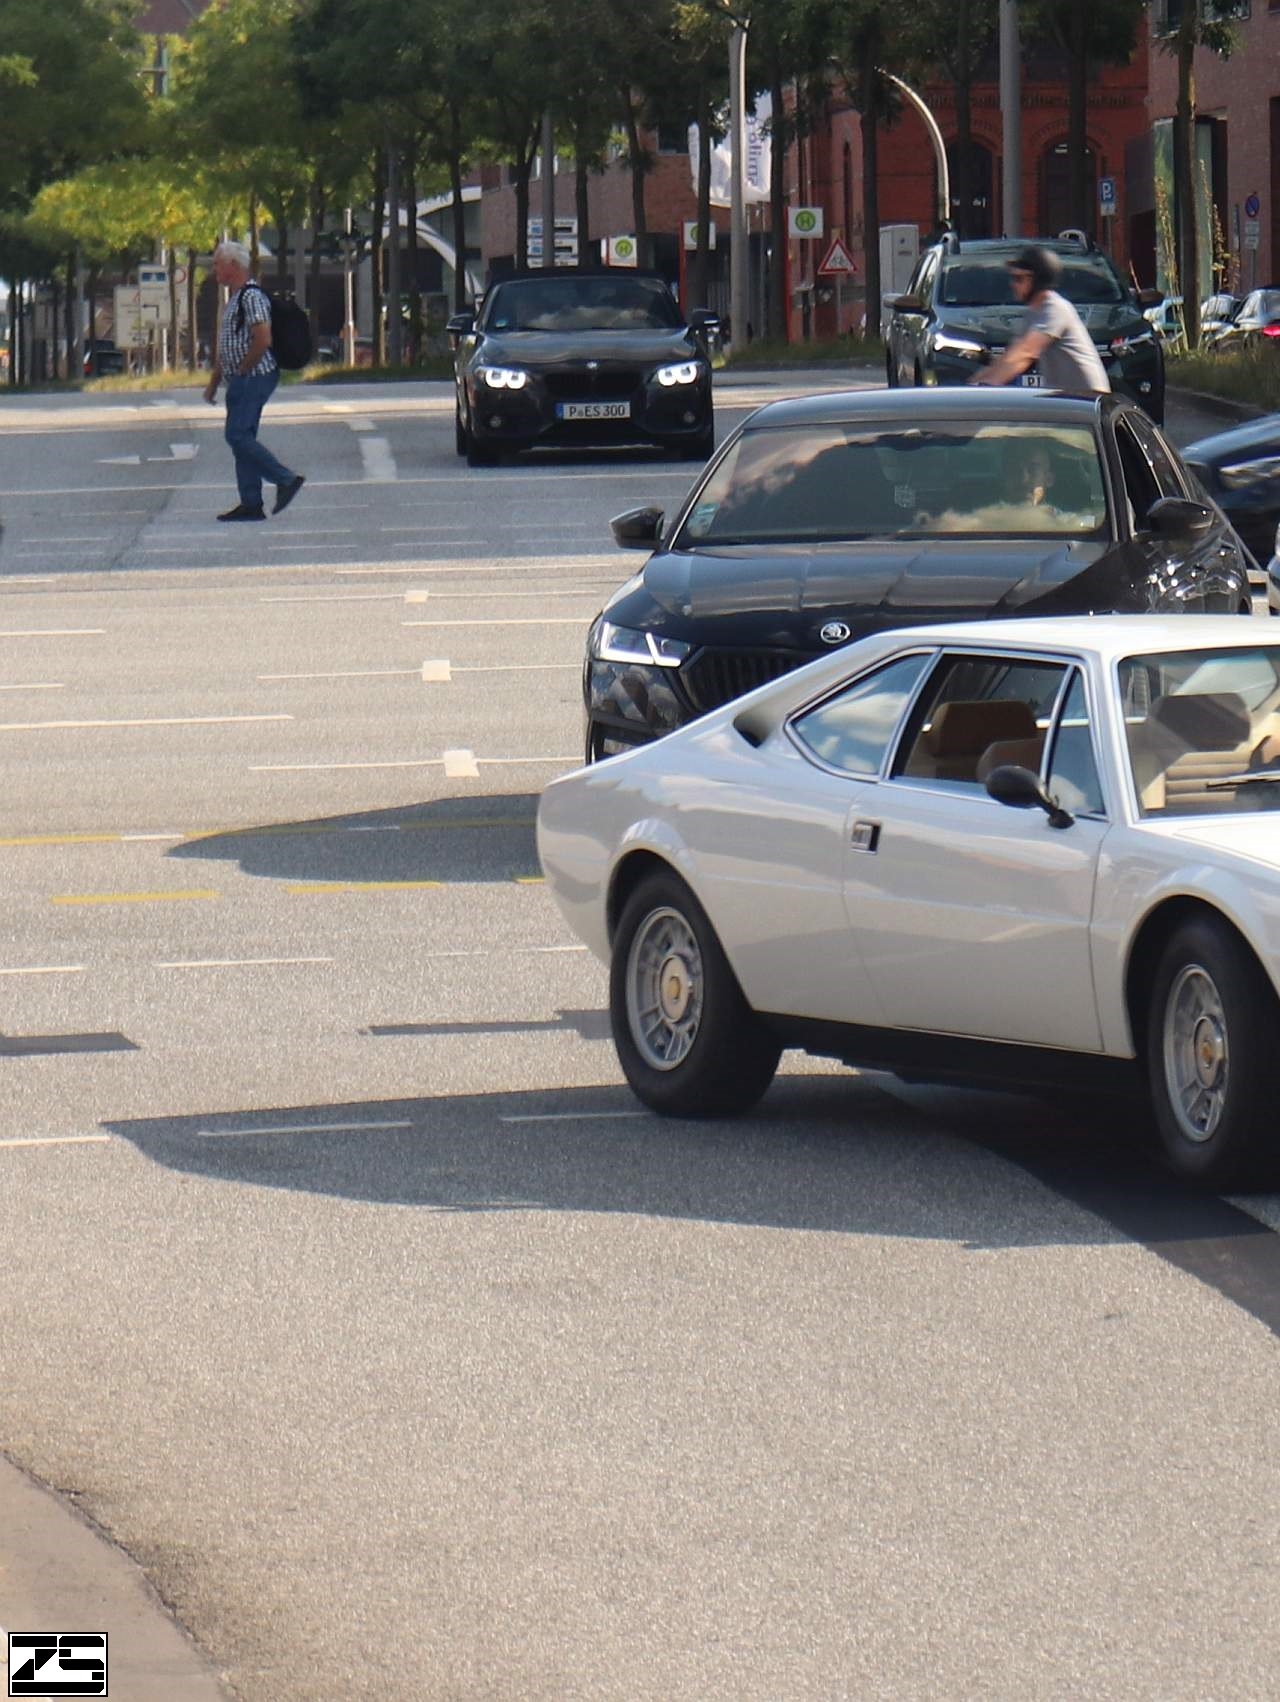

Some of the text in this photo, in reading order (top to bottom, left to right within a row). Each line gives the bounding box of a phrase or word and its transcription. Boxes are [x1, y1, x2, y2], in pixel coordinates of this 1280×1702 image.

[569, 405, 625, 417] P ES 300
